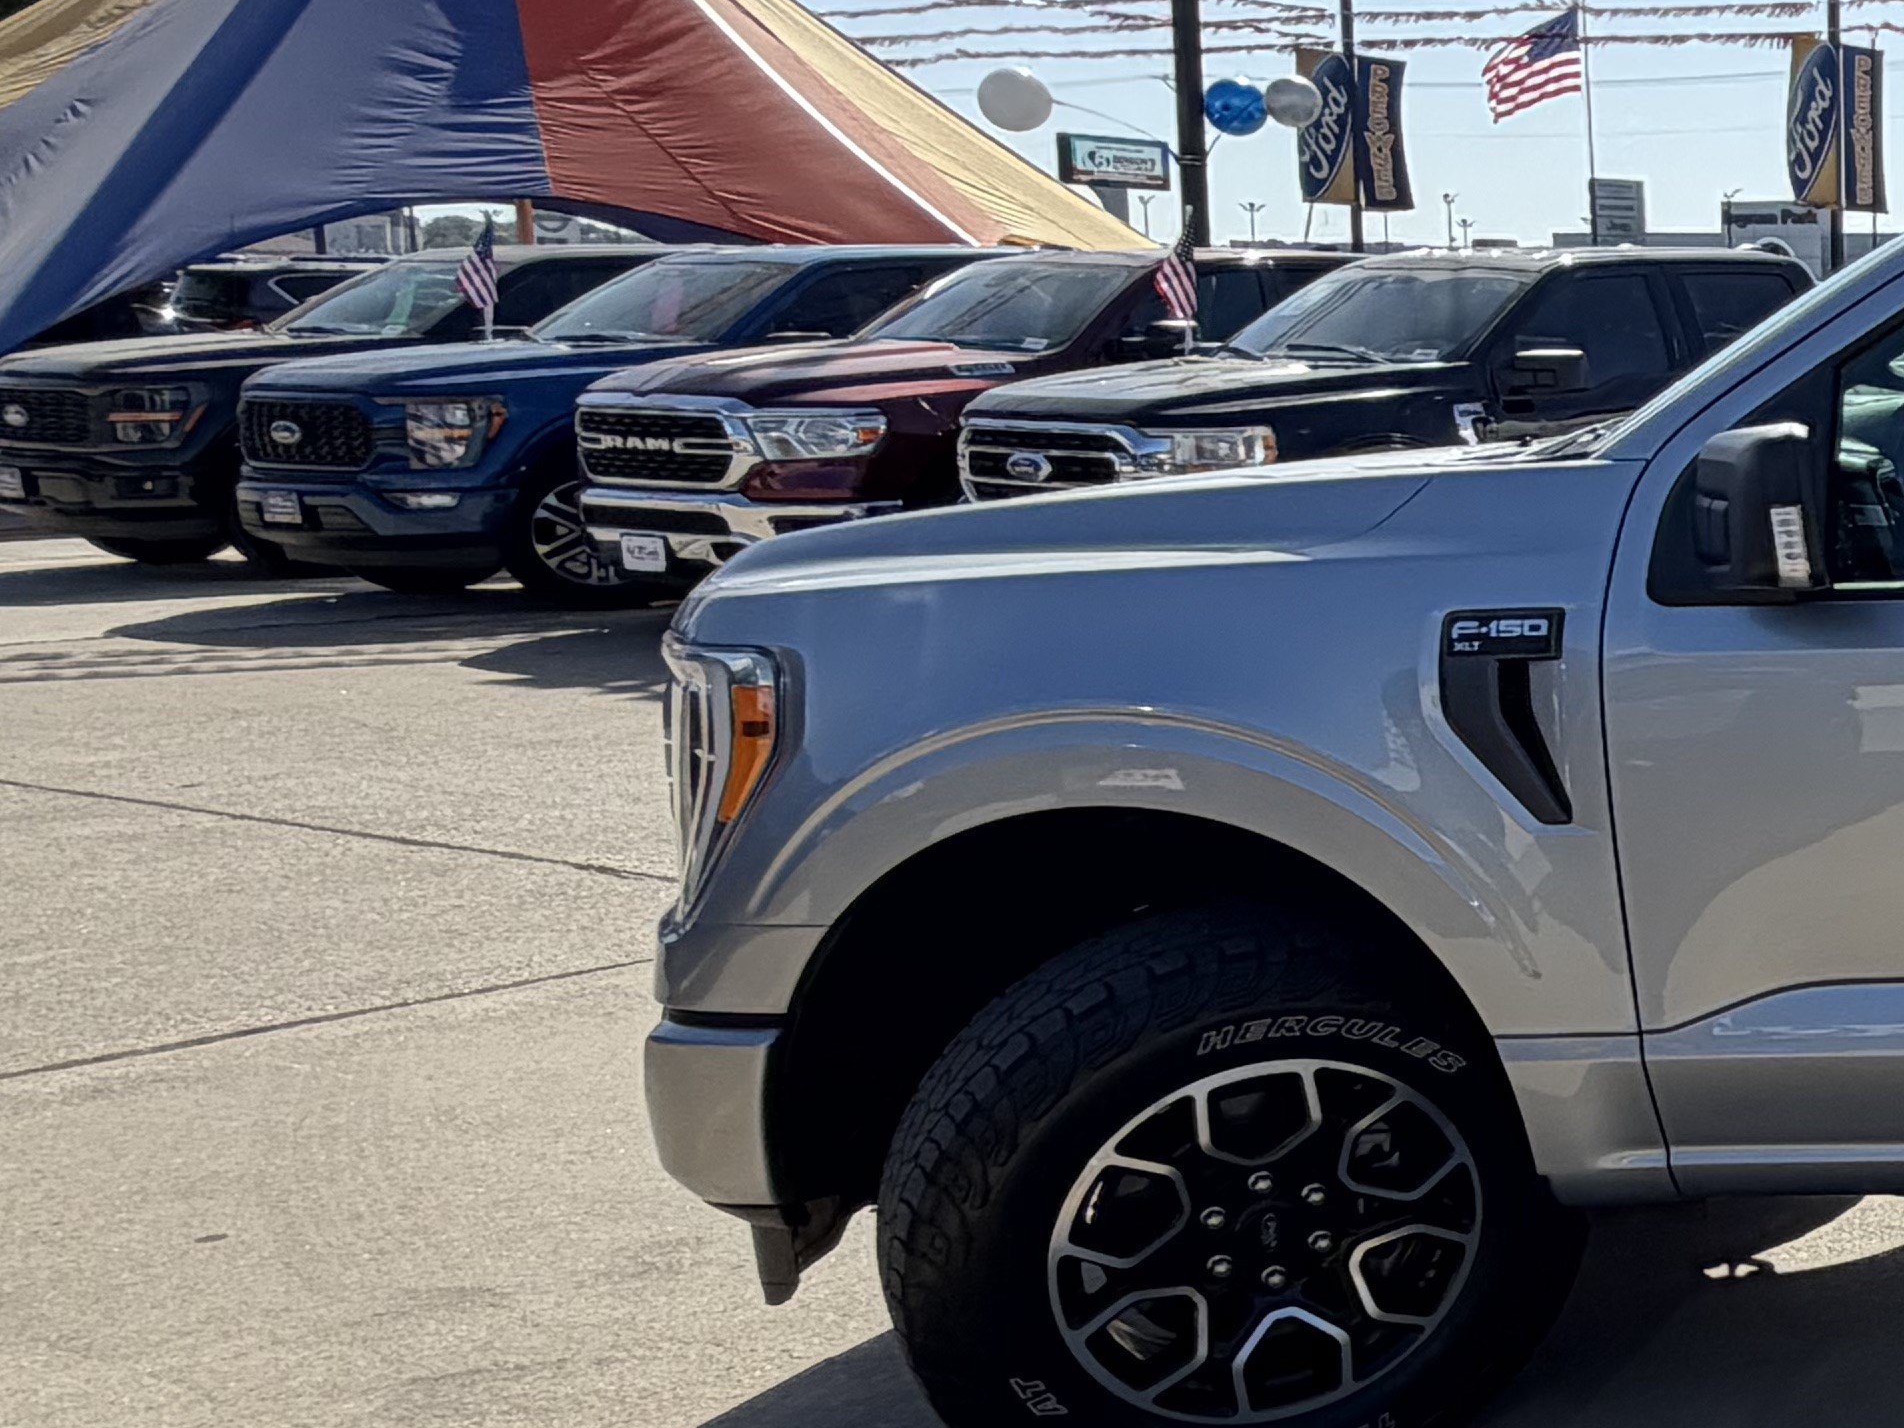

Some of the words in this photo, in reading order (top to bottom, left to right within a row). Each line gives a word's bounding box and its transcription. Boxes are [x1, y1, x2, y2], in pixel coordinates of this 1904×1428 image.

[1300, 76, 1348, 179] Ford
[1790, 67, 1833, 179] Ford
[601, 434, 670, 451] RAM
[1451, 619, 1549, 639] F-150
[1453, 641, 1482, 651] XLT
[1196, 1015, 1467, 1073] HERCULES
[1009, 1376, 1069, 1417] AT
